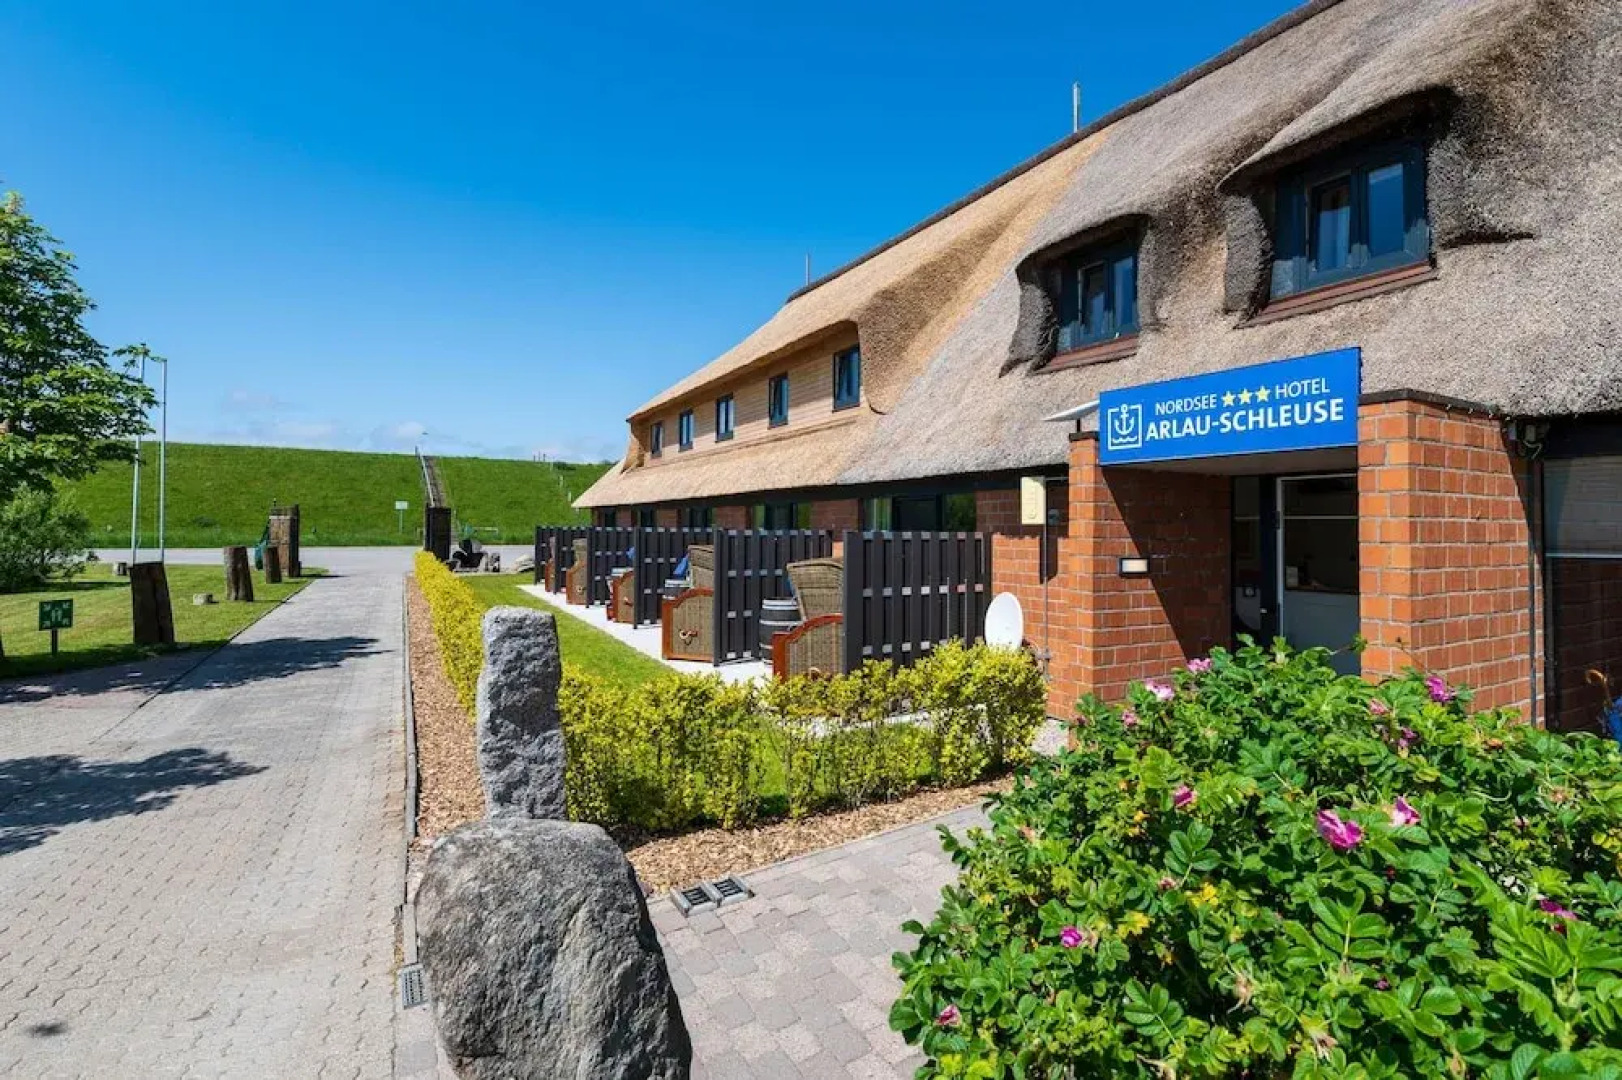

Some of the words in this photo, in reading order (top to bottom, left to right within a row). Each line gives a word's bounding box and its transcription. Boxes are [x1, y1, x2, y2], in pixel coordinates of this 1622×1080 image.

[1155, 394, 1217, 415] NORDSEE
[1275, 378, 1330, 400] HOTEL
[1145, 398, 1344, 442] ARLAU-SCHLEUSE
